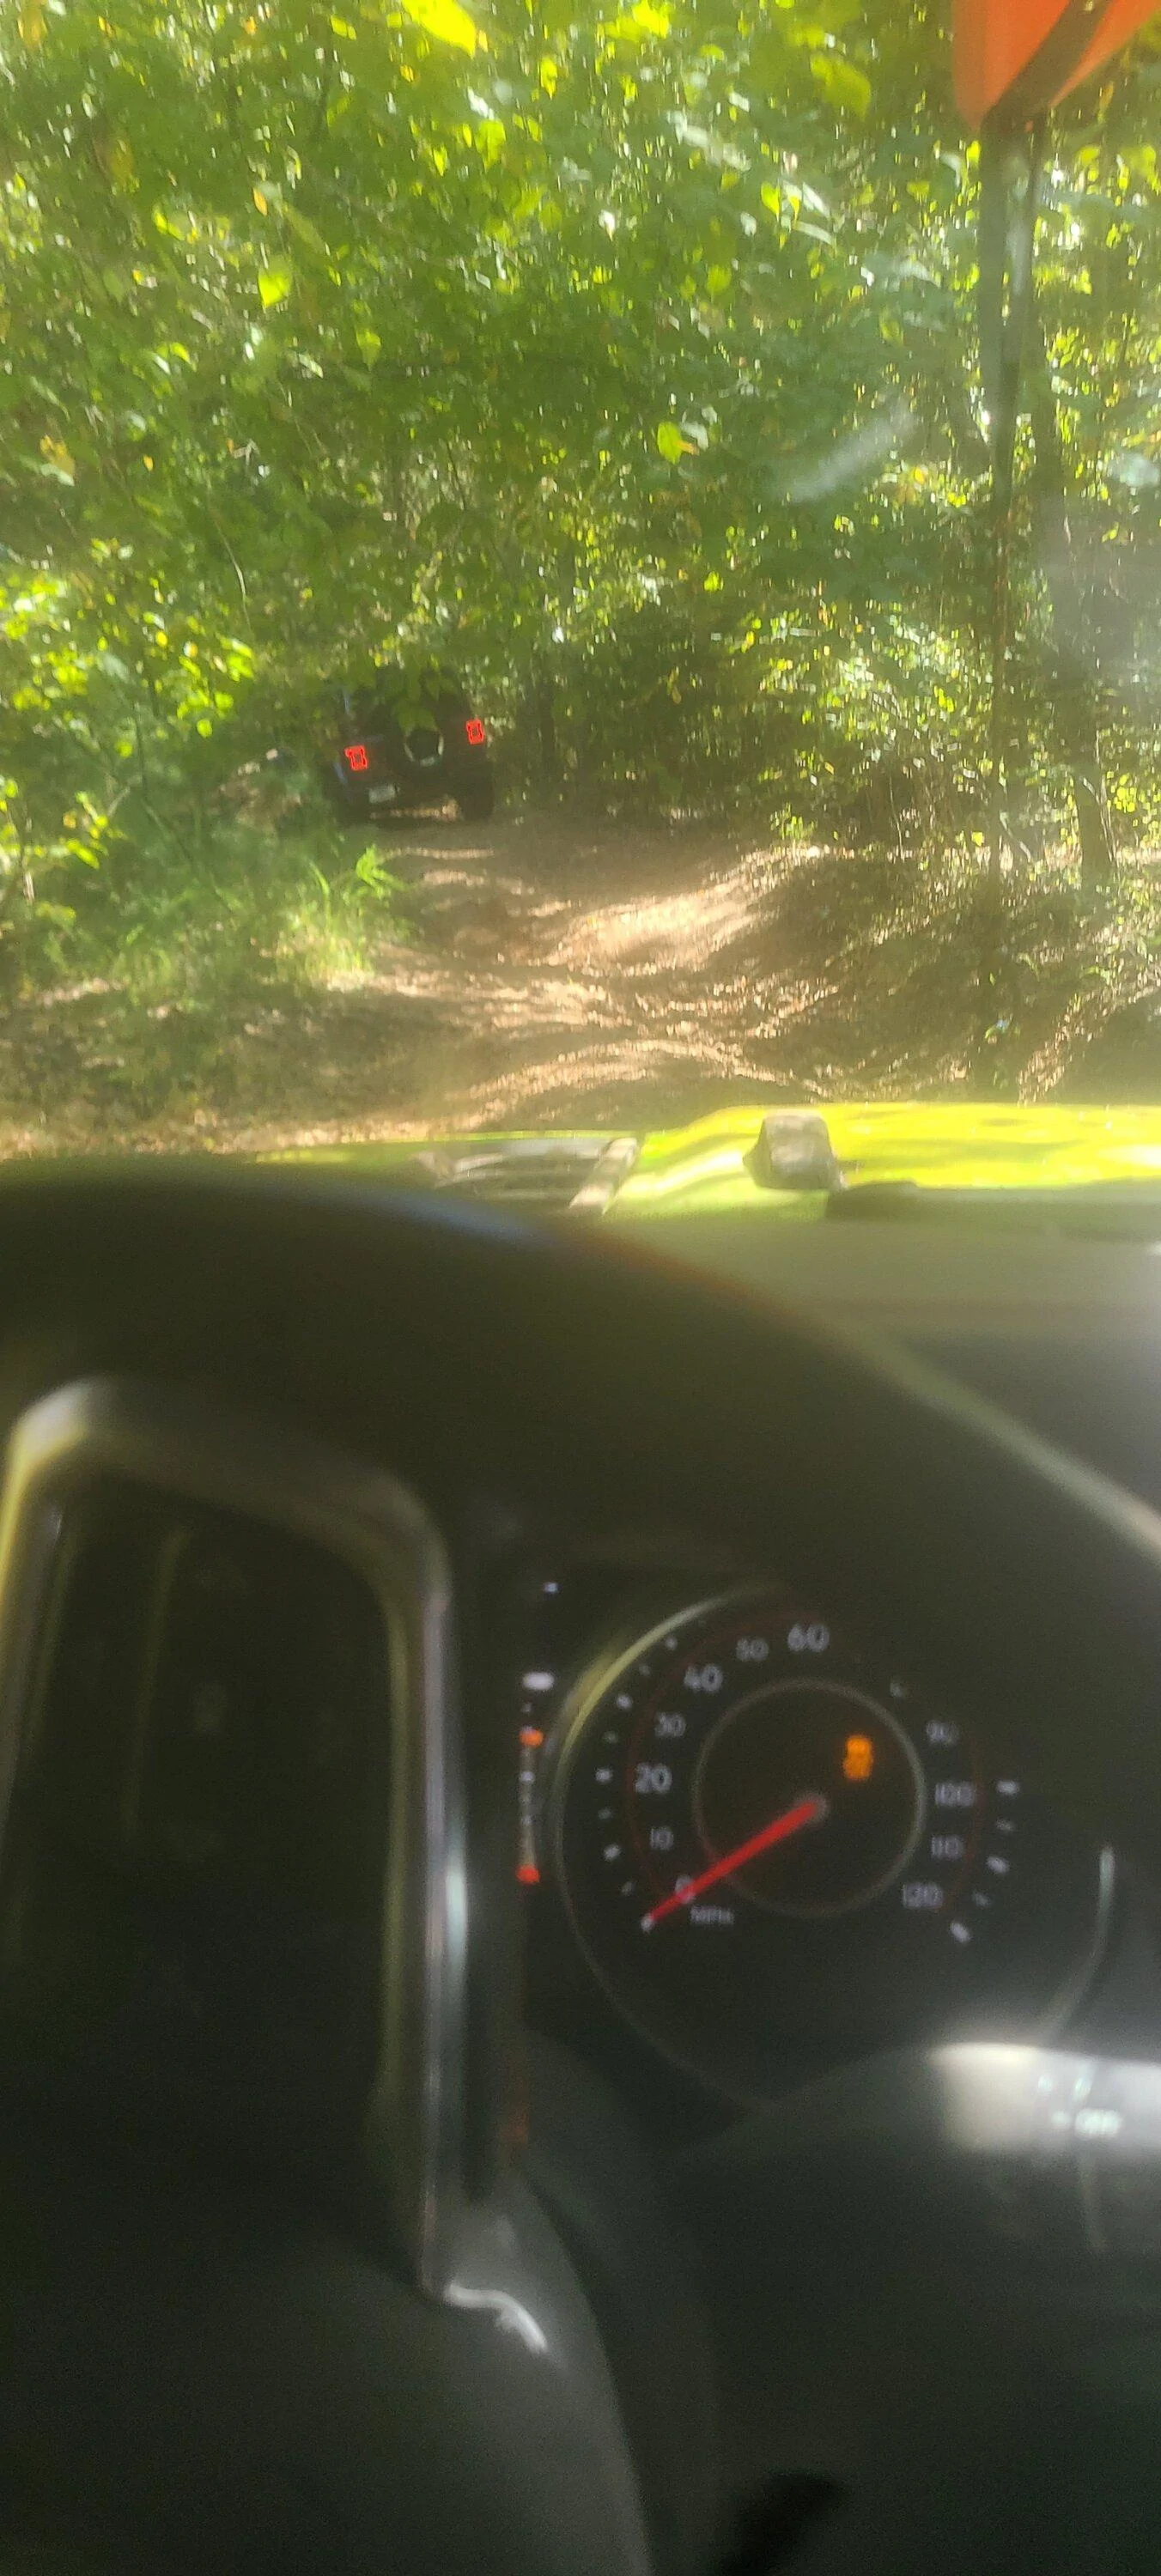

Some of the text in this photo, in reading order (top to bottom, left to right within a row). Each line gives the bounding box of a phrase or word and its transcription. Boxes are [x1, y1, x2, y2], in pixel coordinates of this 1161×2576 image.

[787, 1623, 830, 1652] 60
[684, 1664, 724, 1692] 40
[635, 1763, 672, 1794] 20
